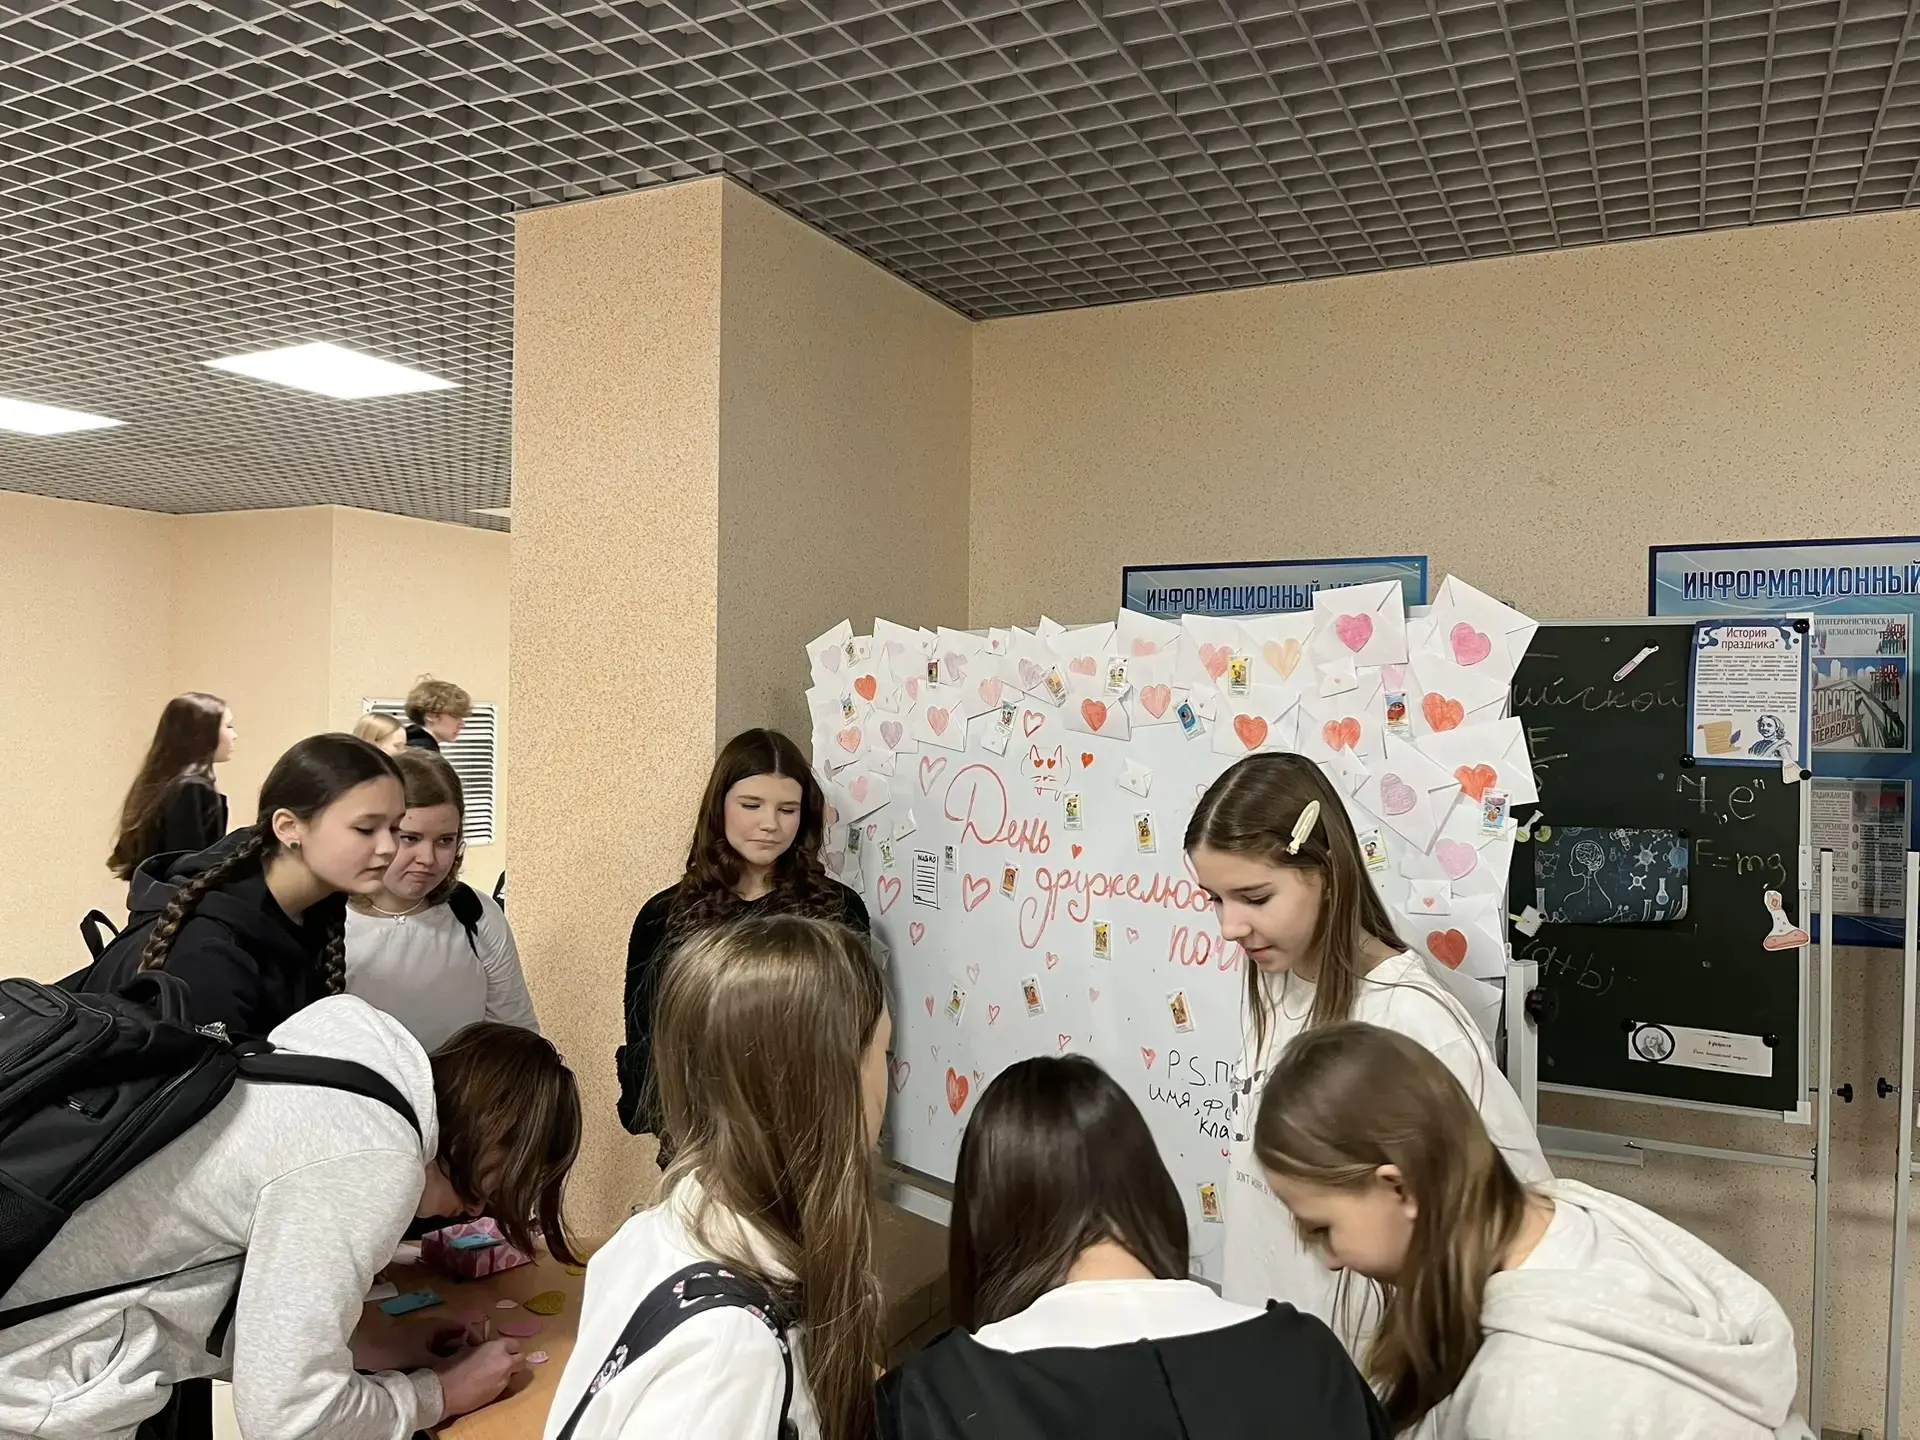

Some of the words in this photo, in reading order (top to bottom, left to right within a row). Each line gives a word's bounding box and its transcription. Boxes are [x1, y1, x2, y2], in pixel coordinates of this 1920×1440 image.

[1726, 627, 1767, 639] История
[1828, 628, 1878, 636] БЕЗОПАСНОСТЬ
[1721, 640, 1775, 651] праздника
[1815, 717, 1856, 743] ТЕРРОРА!
[944, 763, 1051, 854] День
[1019, 856, 1213, 949] дружелюб
[1215, 1060, 1234, 1084] П
[1199, 1117, 1230, 1138] кла
